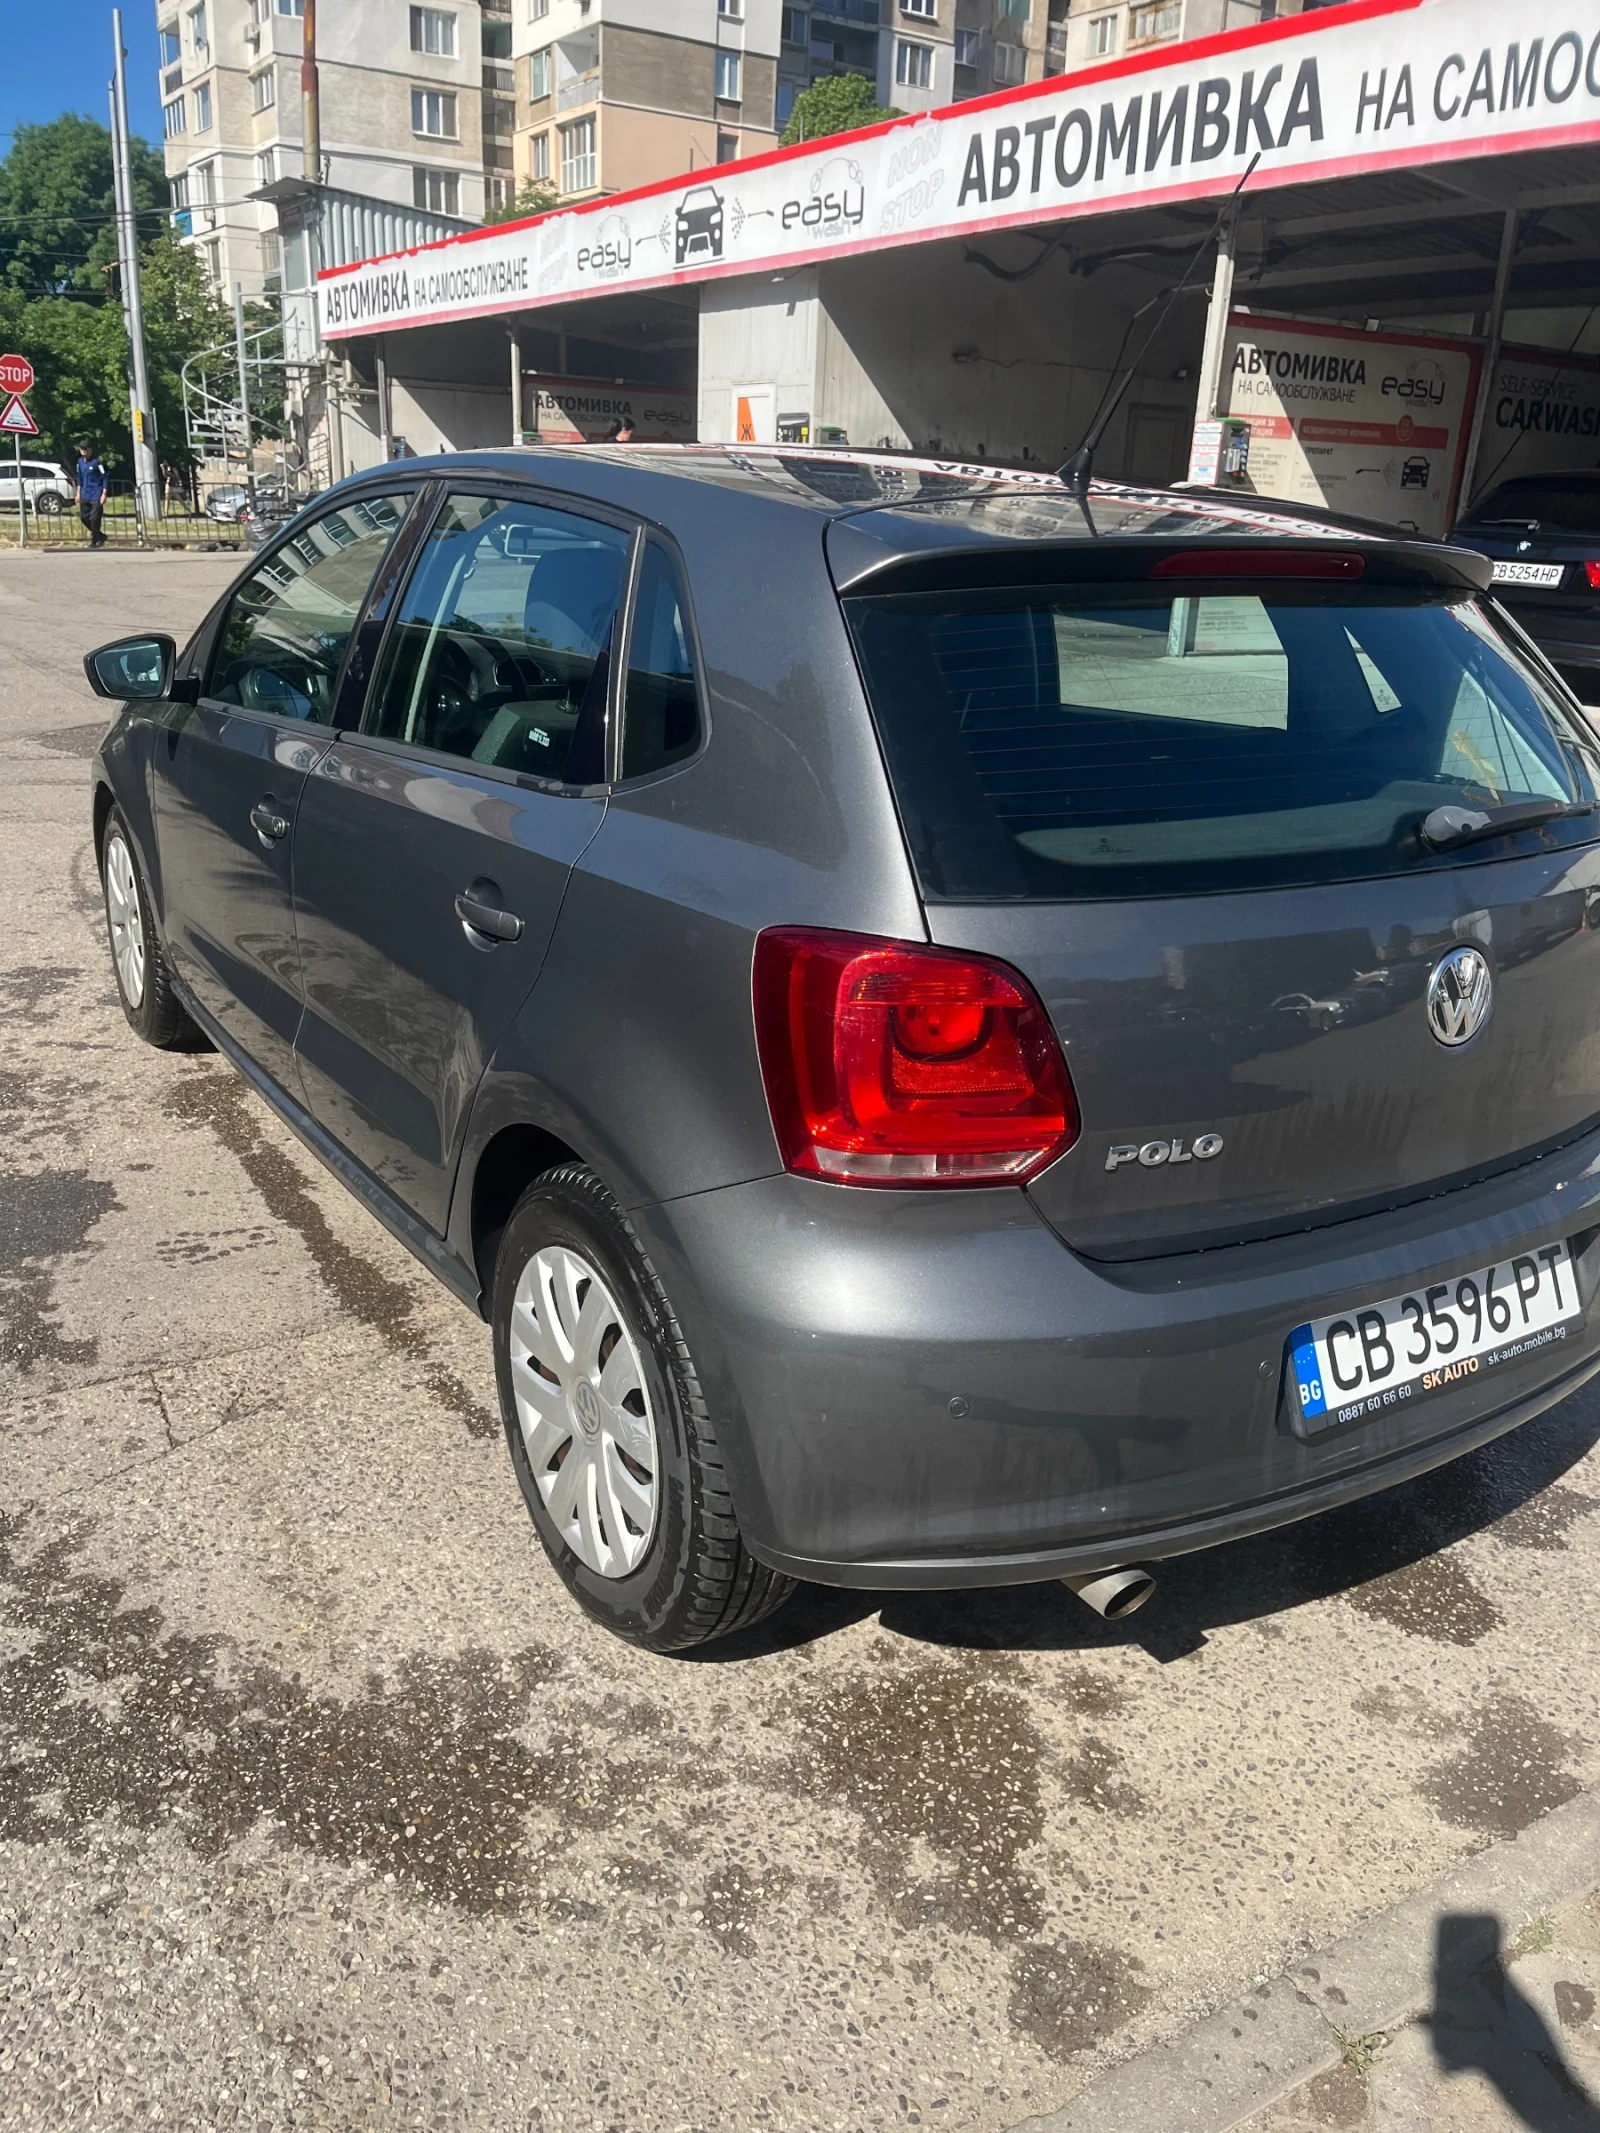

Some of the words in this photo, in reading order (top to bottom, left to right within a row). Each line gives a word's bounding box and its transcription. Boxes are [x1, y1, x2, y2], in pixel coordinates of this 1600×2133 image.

[957, 57, 1323, 207] АВТОМИВКА
[1355, 63, 1415, 134] НА
[887, 123, 943, 189] NON
[782, 186, 864, 230] easy
[880, 169, 944, 236] STOP
[577, 238, 631, 271] easy
[327, 270, 410, 325] АВТОМИВКА
[414, 278, 428, 307] НА
[428, 256, 529, 304] САМООБСЛУЖВАНЕ
[0, 365, 30, 383] STOP
[1231, 347, 1366, 385] АВТОМИВКА
[535, 394, 632, 416] АВТОМИВКА
[1238, 379, 1252, 394] НА
[1256, 380, 1356, 404] САМООБСЛУЖВАНЕ
[1381, 375, 1446, 405] easy
[541, 411, 552, 420] НА
[644, 409, 692, 425] easy
[1305, 446, 1333, 456] ПРЕПАРАТ
[1508, 565, 1540, 581] 5254
[1540, 567, 1559, 582] HP
[1104, 1133, 1223, 1171] POLO
[1326, 1309, 1395, 1391] CB
[1401, 1268, 1511, 1364] 3596
[1512, 1245, 1564, 1324] PT
[1487, 1325, 1566, 1366] sk-auto.mobile.bg
[1422, 1372, 1441, 1391] SK
[1443, 1357, 1479, 1384] AUTO
[1299, 1380, 1322, 1406] BG
[1338, 1402, 1364, 1423] 0887
[1367, 1396, 1380, 1411] 60
[1382, 1390, 1396, 1405] 66
[1398, 1384, 1411, 1399] 60
